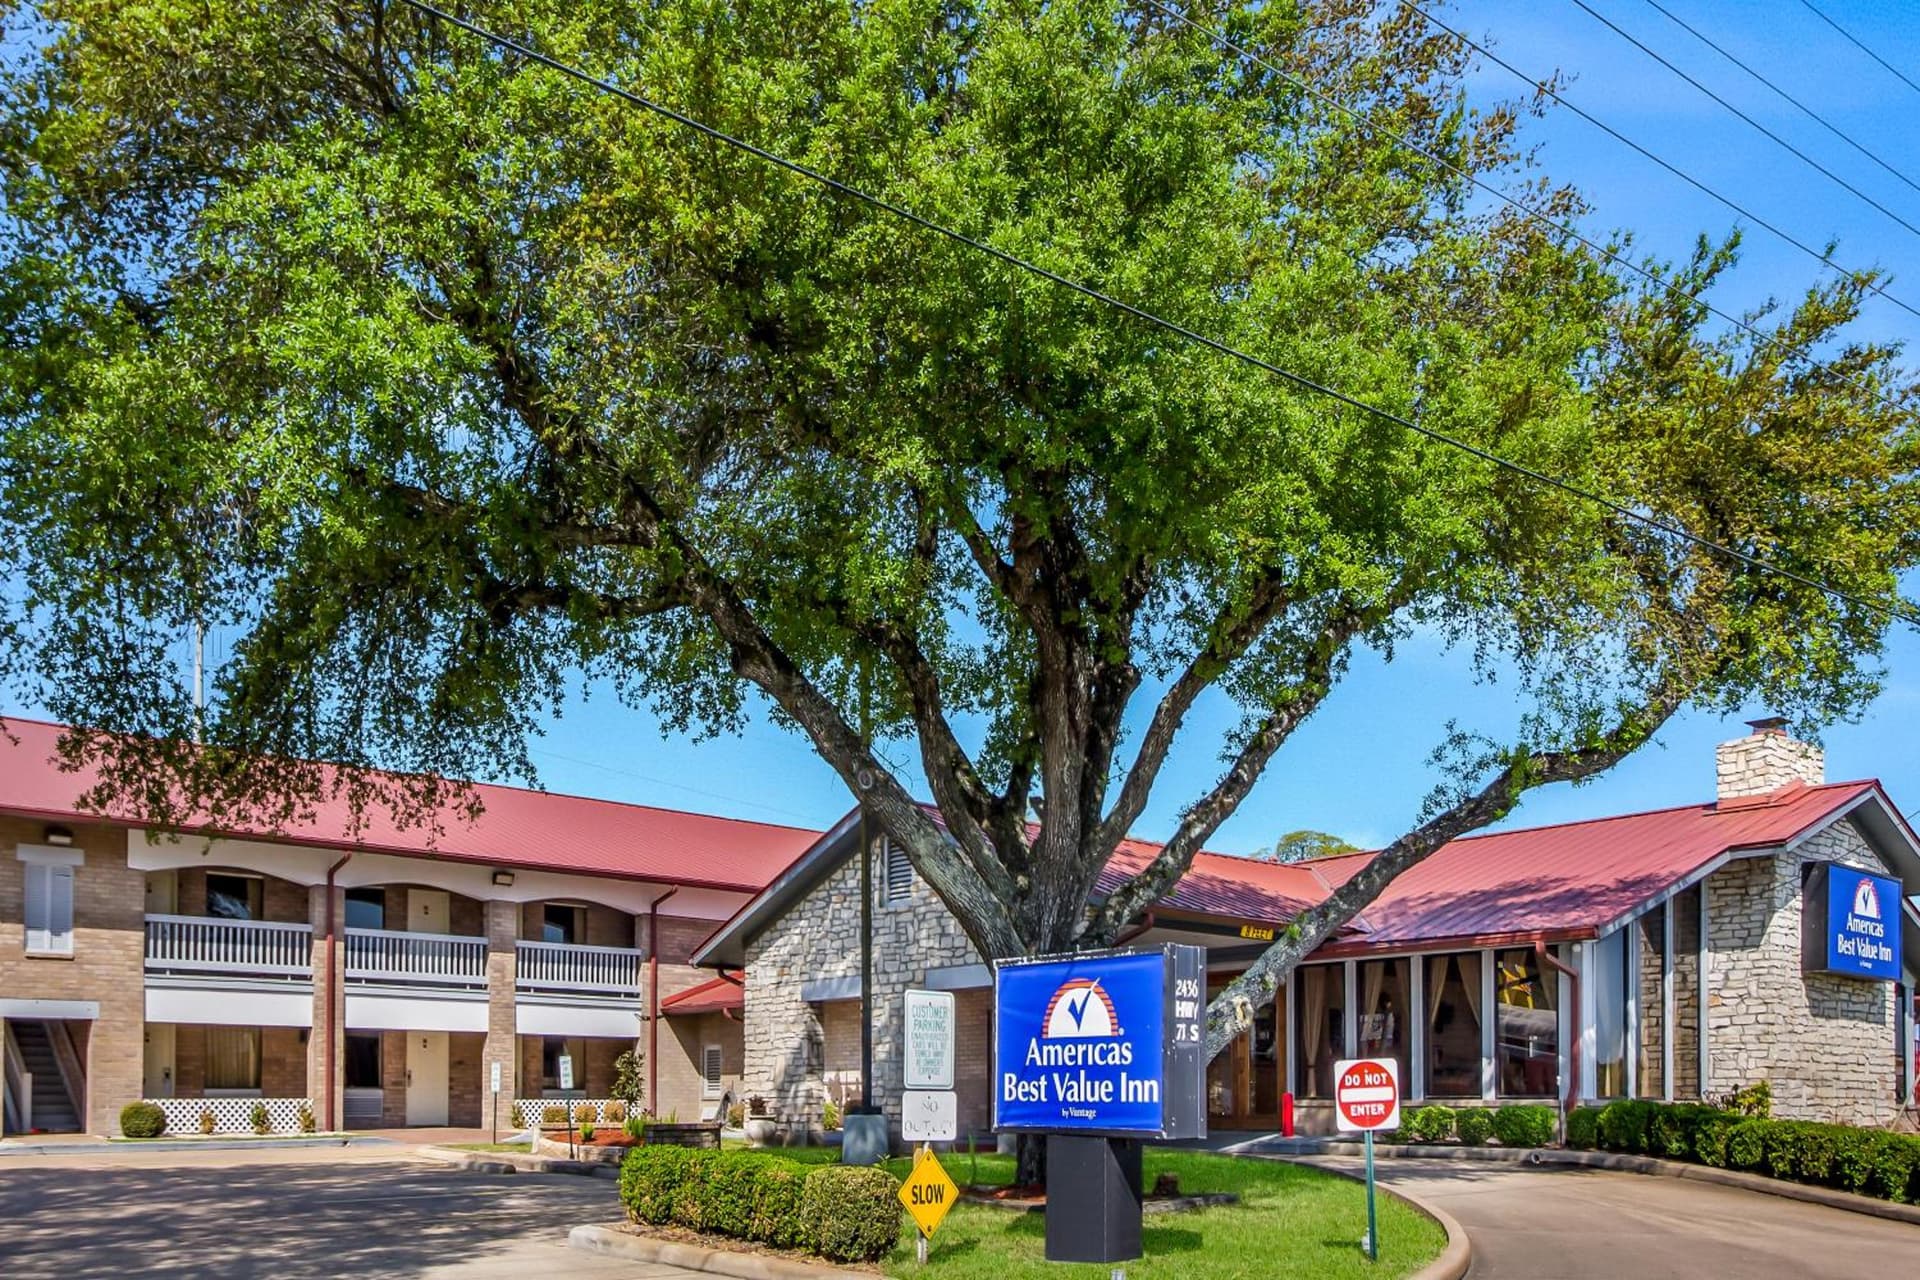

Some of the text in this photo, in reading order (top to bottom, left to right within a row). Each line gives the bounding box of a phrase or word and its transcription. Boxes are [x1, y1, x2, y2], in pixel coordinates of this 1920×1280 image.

[1846, 912, 1884, 937] Americas
[1837, 934, 1892, 962] Best Value Inn
[1175, 979, 1198, 998] 2436
[911, 1004, 948, 1019] CUSTOMER
[1175, 1000, 1199, 1020] HWY
[913, 1019, 946, 1032] PARKING
[1176, 1023, 1199, 1042] 71 S
[1025, 1037, 1132, 1066] Americas
[1004, 1070, 1159, 1103] Best Value Inn
[1344, 1073, 1388, 1086] DO NOT
[1061, 1106, 1097, 1119] by Vantage
[1350, 1104, 1385, 1117] ENTER
[911, 1184, 945, 1205] SLOW
